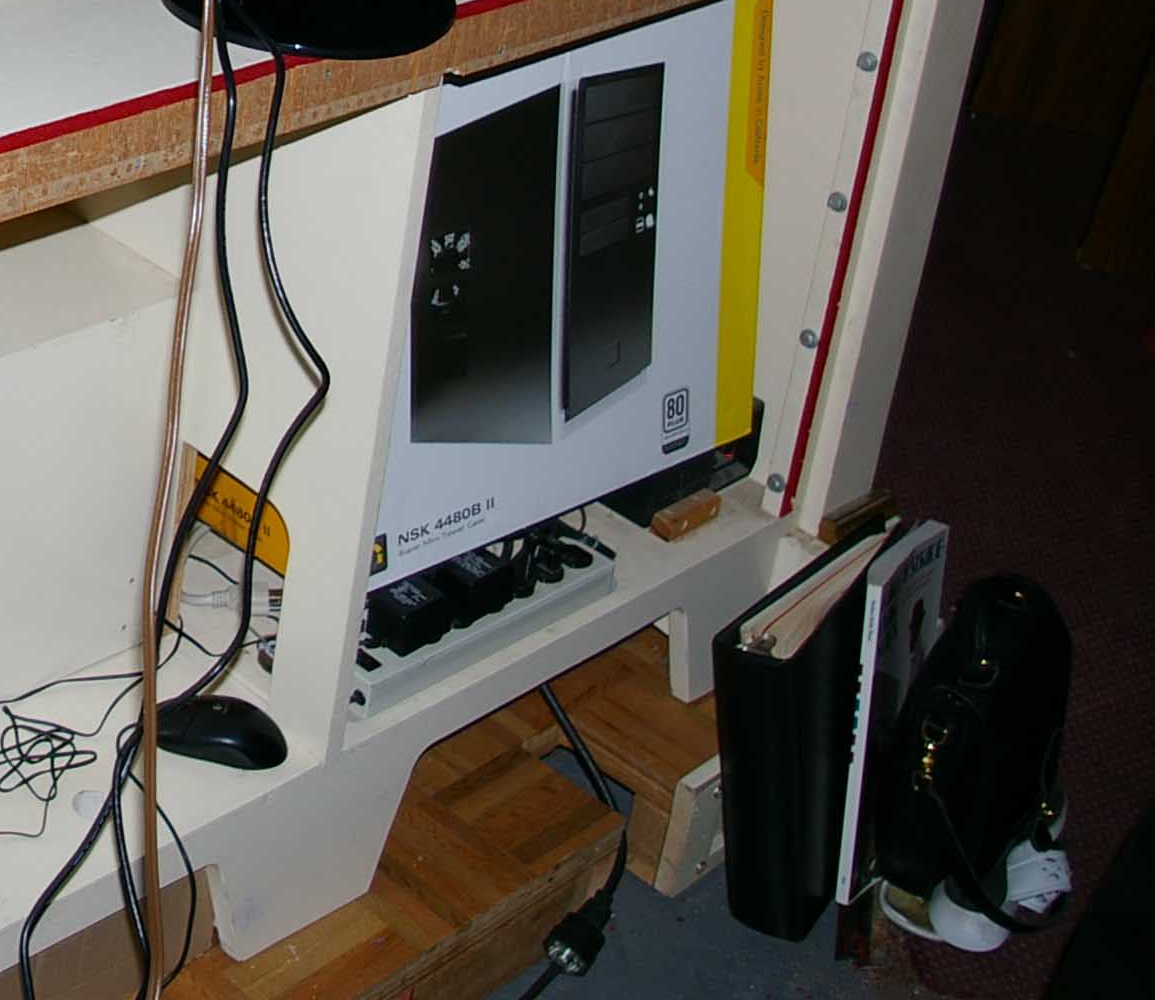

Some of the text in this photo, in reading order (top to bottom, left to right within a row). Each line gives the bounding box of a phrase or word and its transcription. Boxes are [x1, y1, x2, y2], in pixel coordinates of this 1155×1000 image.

[667, 394, 685, 419] 80
[397, 497, 495, 546] NSK 4480B II
